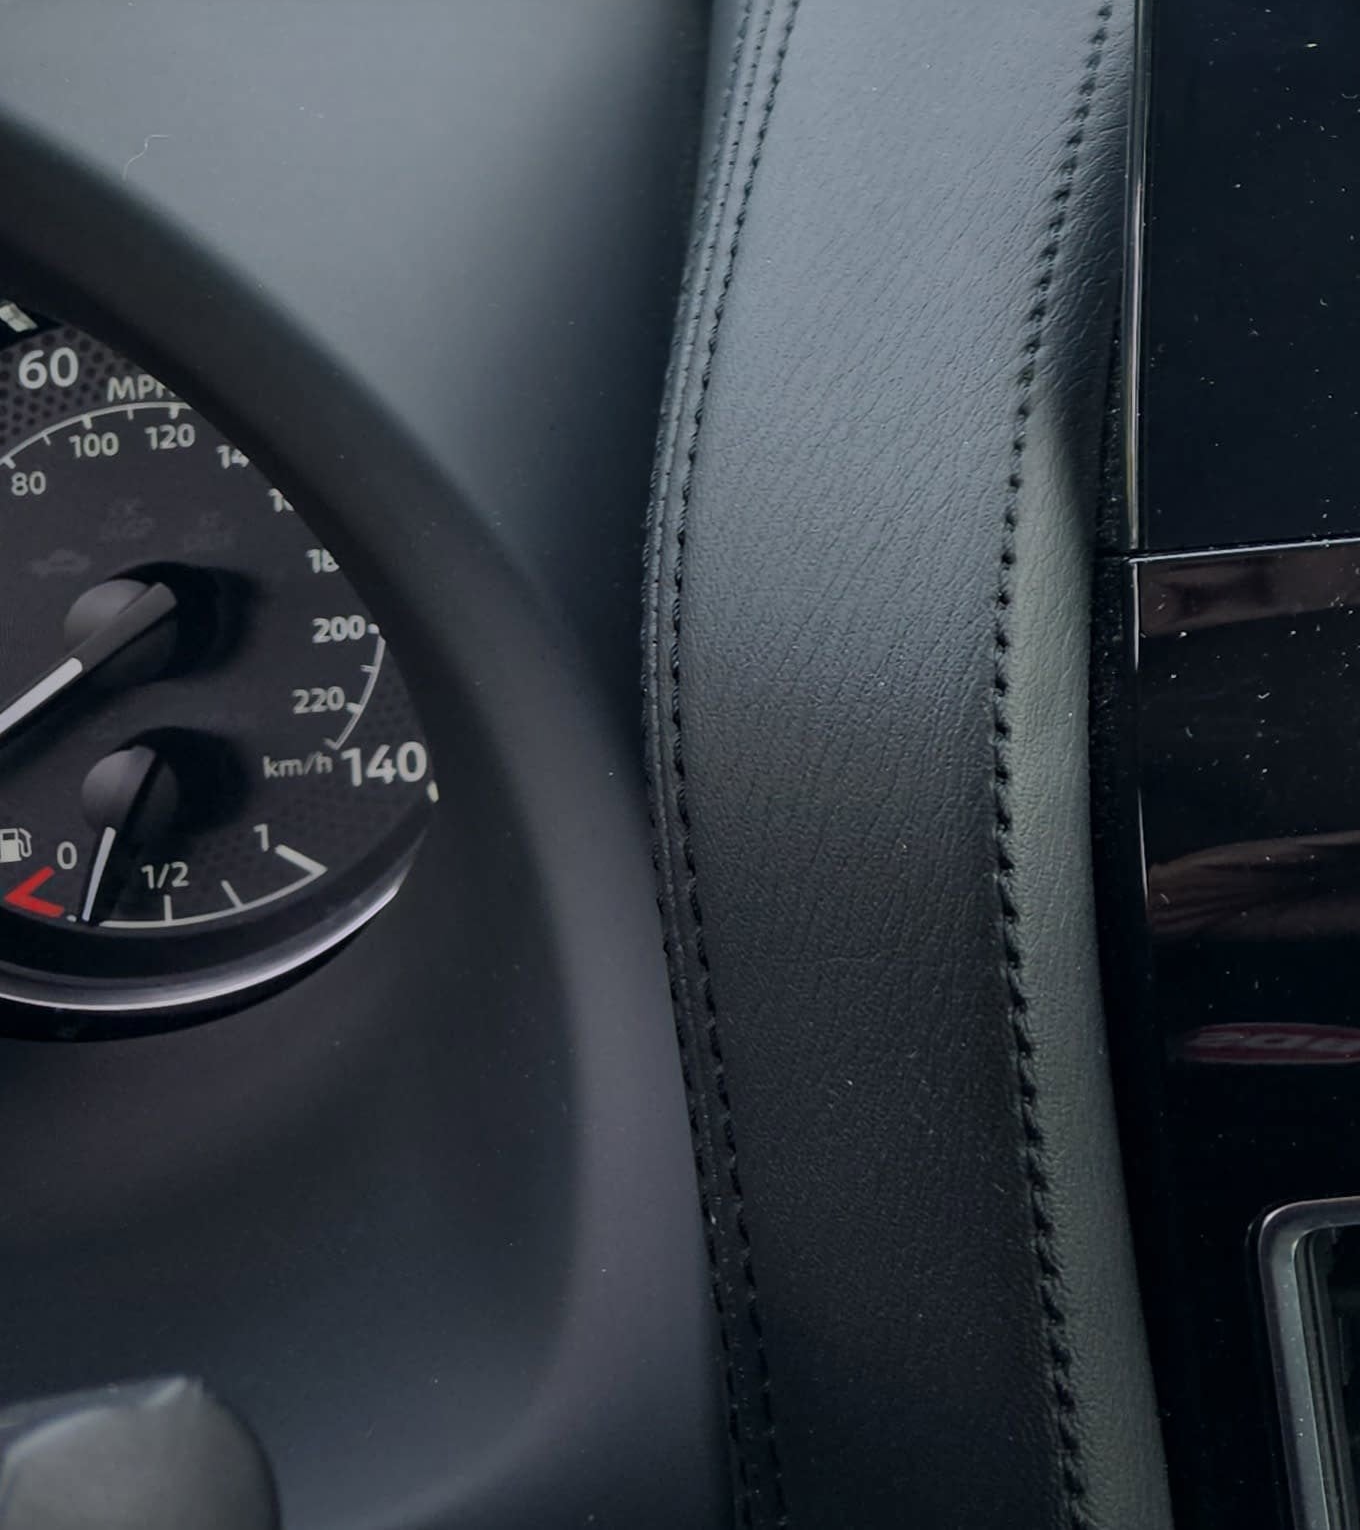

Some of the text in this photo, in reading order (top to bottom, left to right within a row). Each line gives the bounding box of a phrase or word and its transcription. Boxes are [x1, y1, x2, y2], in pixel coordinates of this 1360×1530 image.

[18, 347, 79, 390] 60
[68, 431, 120, 459] 100
[144, 423, 196, 450] 120
[10, 471, 47, 496] 80
[312, 614, 367, 644] 200
[291, 685, 346, 715] 220
[262, 751, 333, 780] km/h
[340, 740, 428, 788] 140
[253, 823, 270, 853] 1
[56, 841, 79, 870] 0
[141, 861, 190, 890] 1/2
